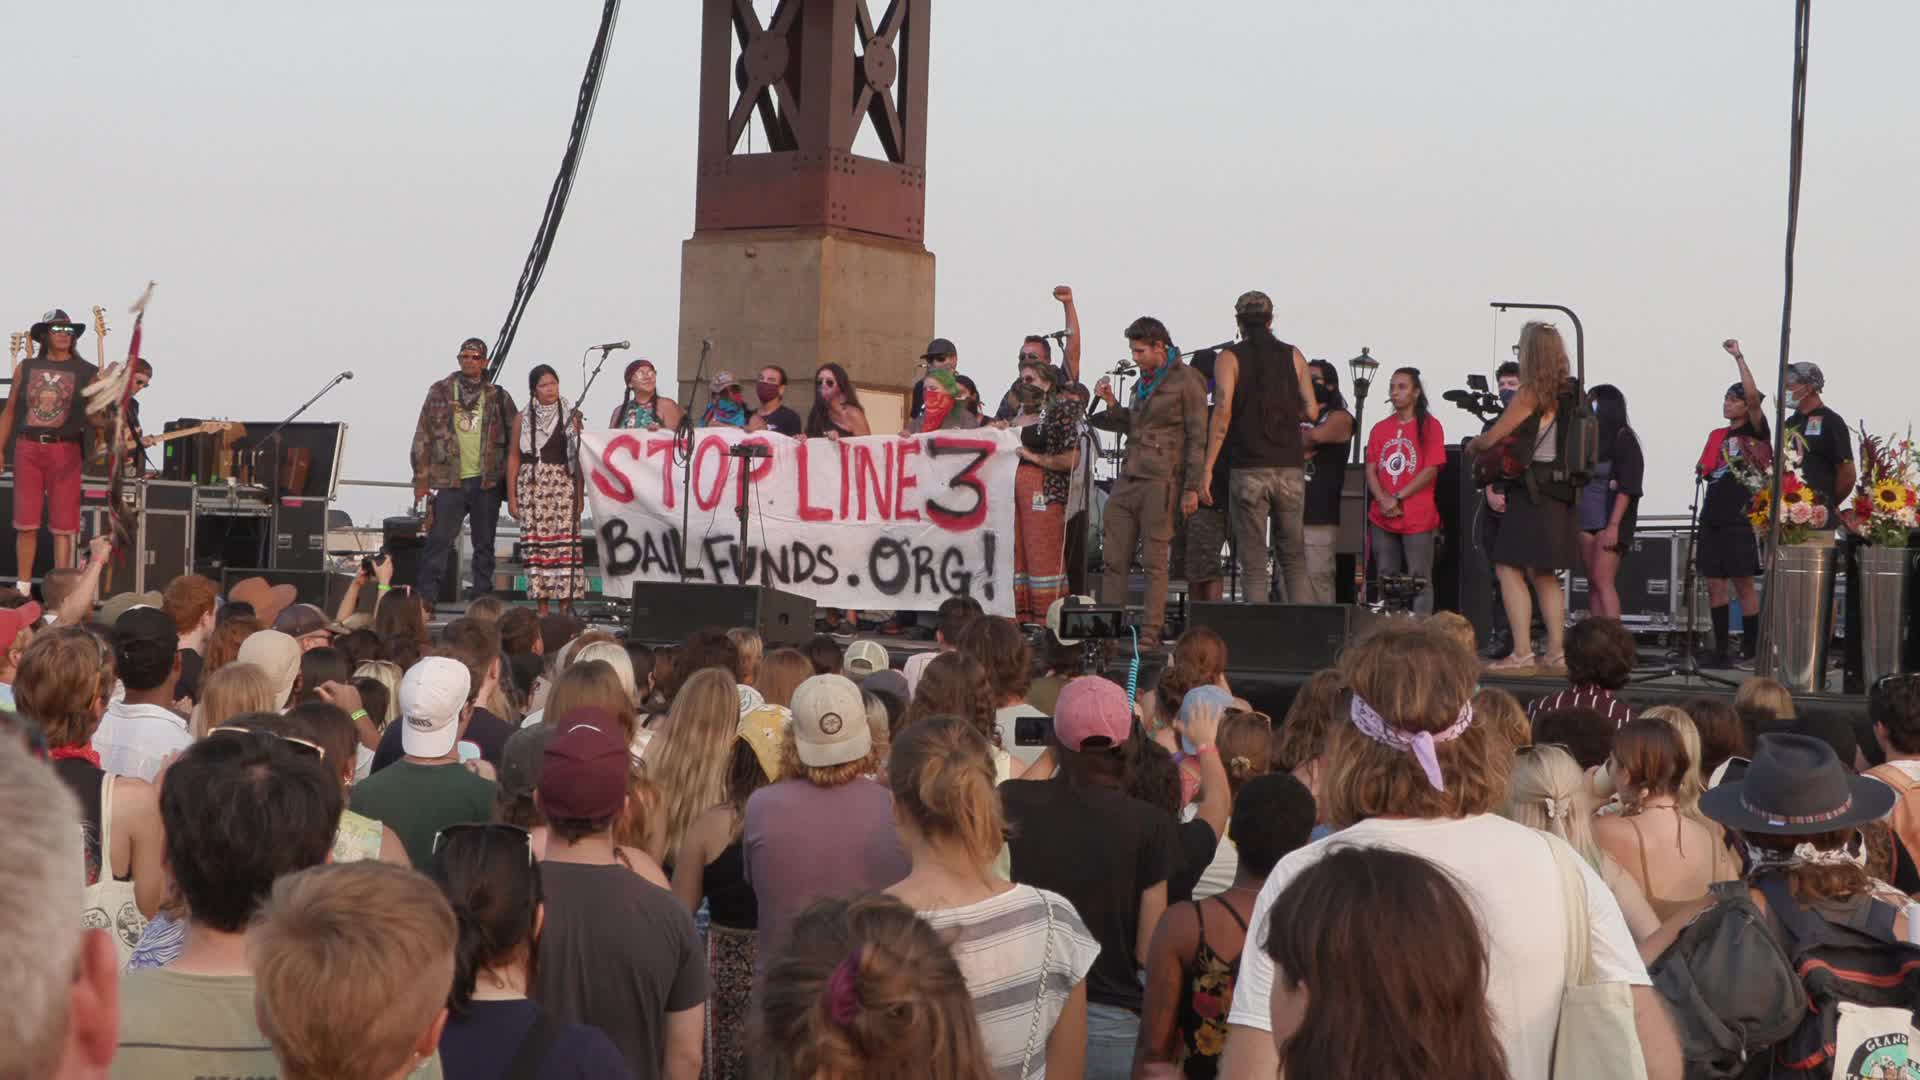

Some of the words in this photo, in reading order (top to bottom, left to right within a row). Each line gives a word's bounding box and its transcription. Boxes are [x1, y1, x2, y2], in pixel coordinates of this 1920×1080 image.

[591, 434, 774, 516] STOP
[796, 439, 921, 522] LINE
[925, 436, 998, 533] 3
